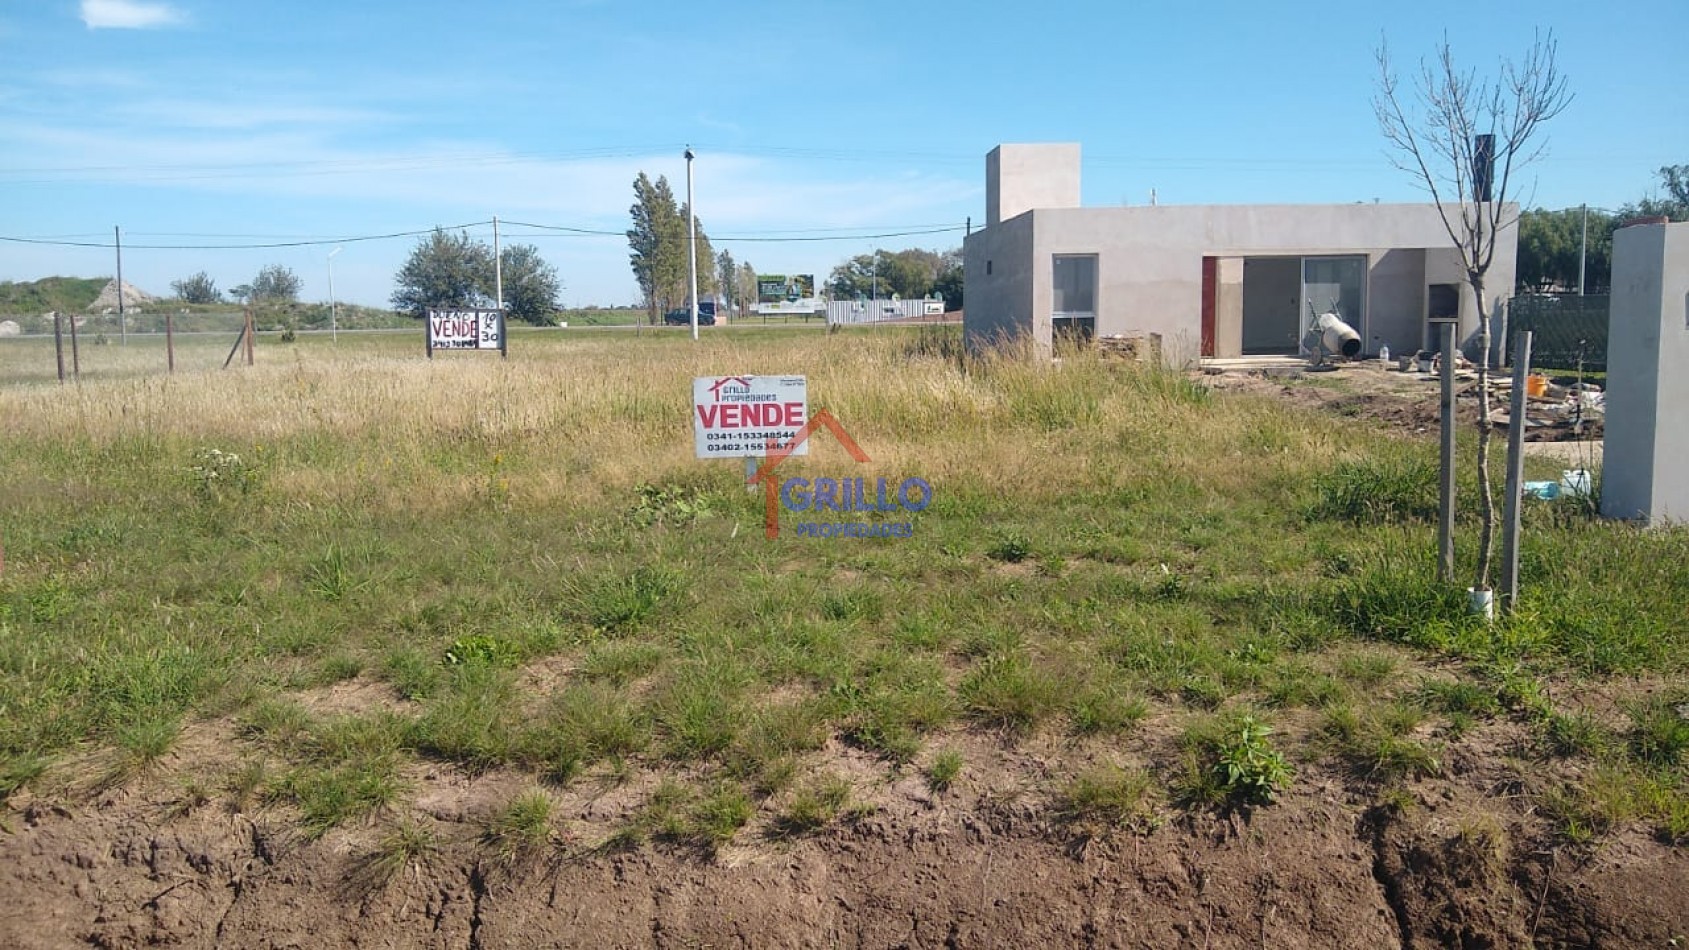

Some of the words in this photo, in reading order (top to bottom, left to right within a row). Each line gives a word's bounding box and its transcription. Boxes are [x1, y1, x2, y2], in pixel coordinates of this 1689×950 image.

[433, 320, 477, 338] VENDE
[481, 331, 498, 342] 30
[697, 402, 804, 429] VENDE
